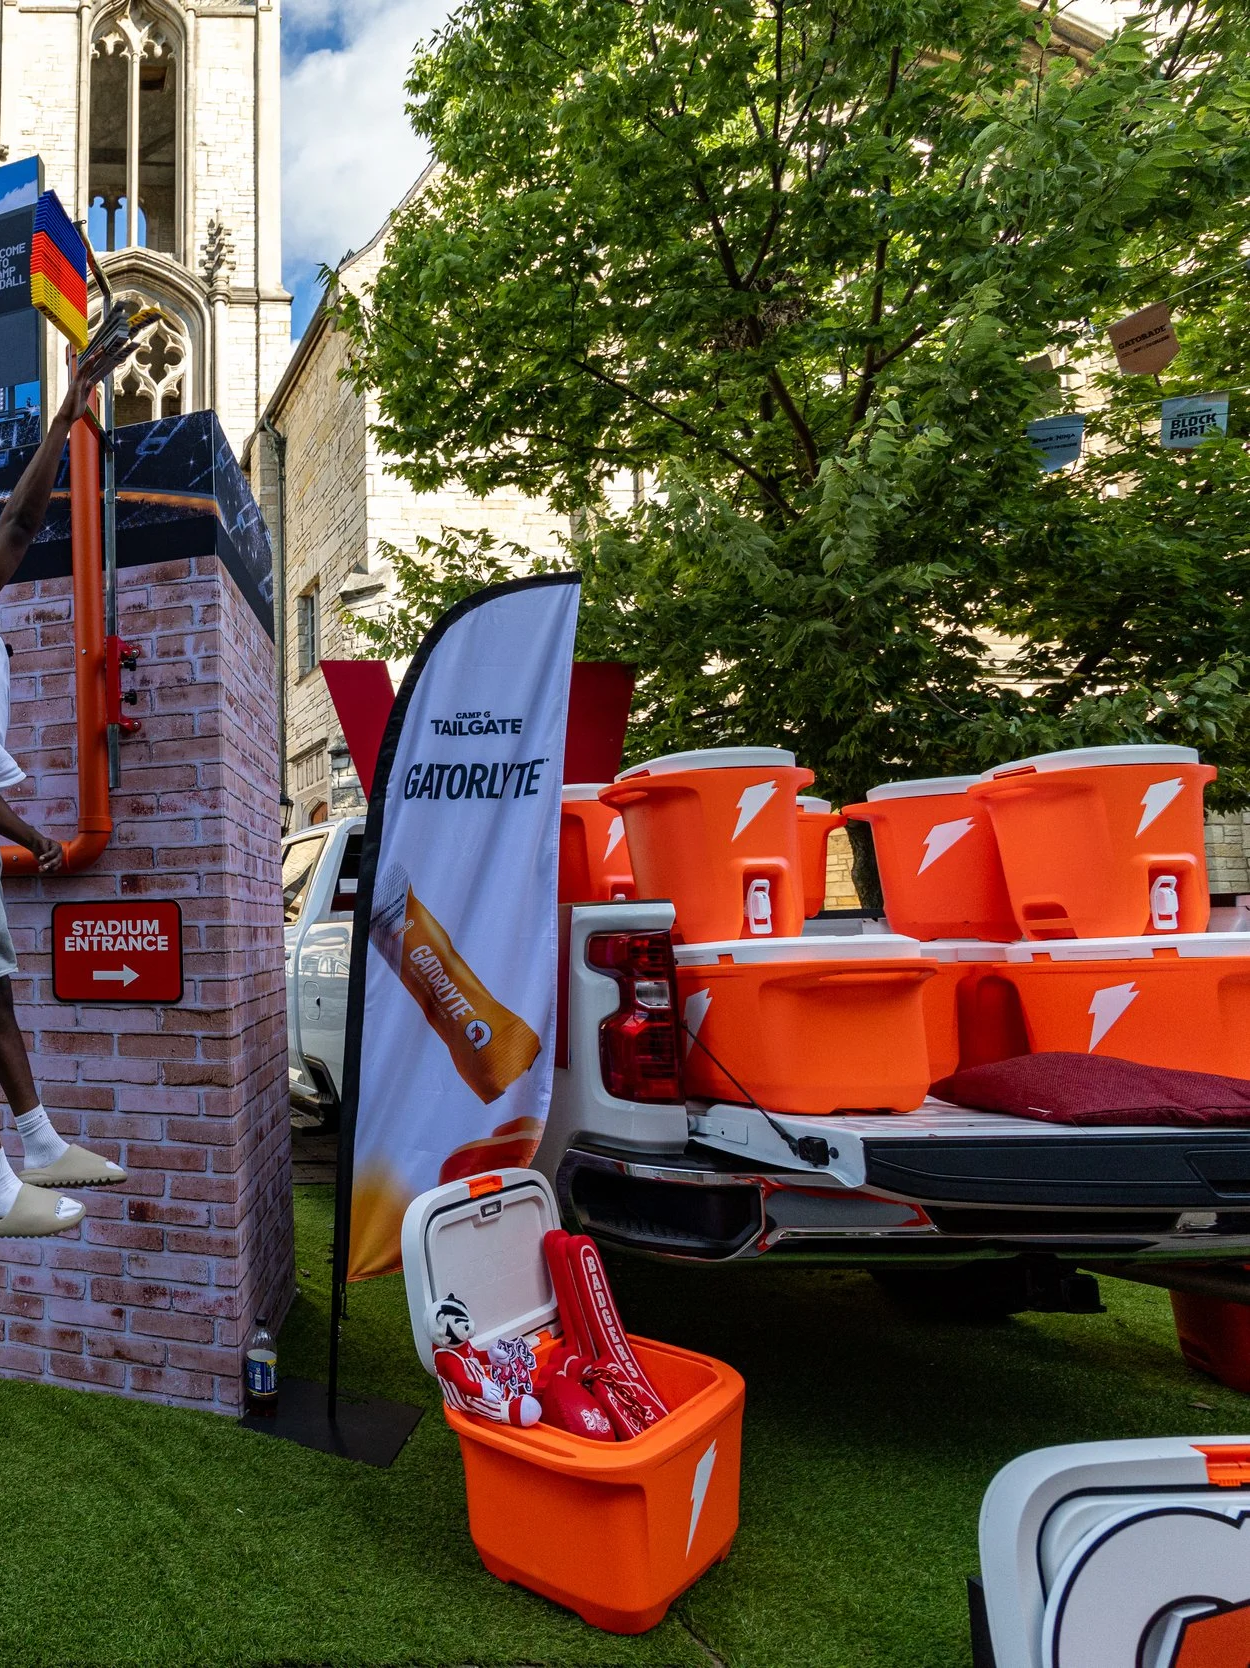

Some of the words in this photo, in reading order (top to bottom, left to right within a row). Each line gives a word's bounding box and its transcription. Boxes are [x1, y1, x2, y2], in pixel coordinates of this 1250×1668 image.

[1117, 323, 1167, 350] GATORADE
[1171, 412, 1217, 430] BLOCK
[1169, 423, 1218, 440] PART
[455, 711, 481, 719] CAMP
[431, 718, 523, 737] TAILGATE
[404, 758, 545, 800] GATORLYTE
[71, 919, 160, 936] STADIUM
[64, 935, 169, 952] ENTRANCE
[409, 944, 475, 1021] GATORLYTE
[586, 1256, 639, 1379] BADGERS
